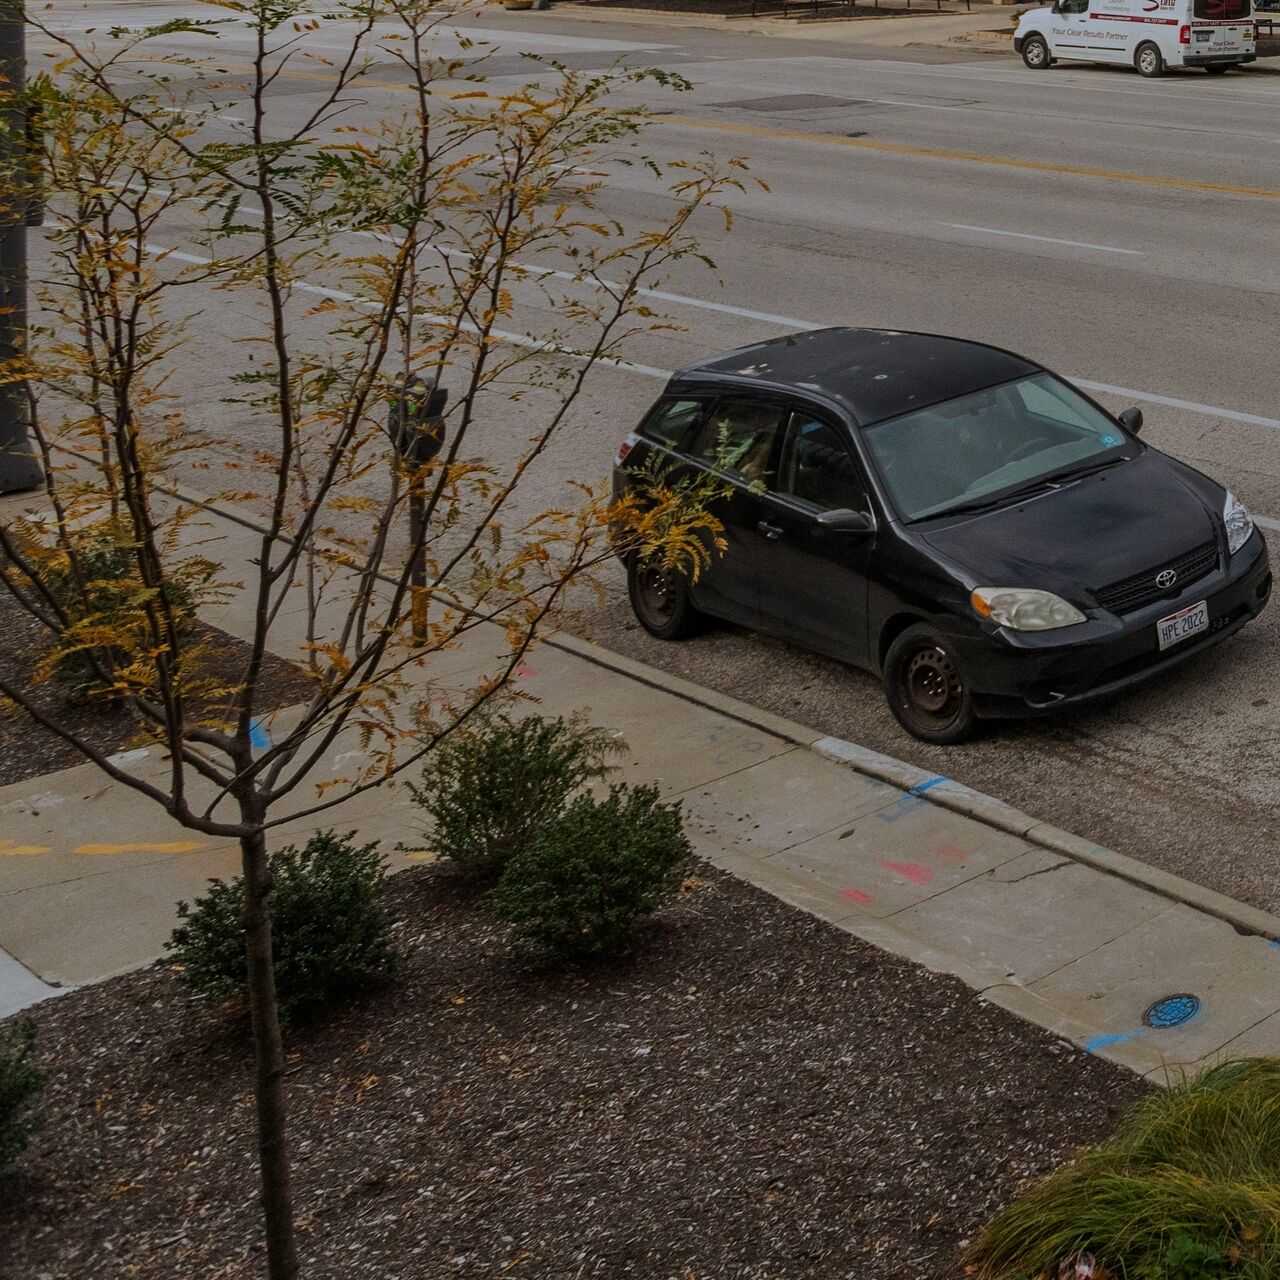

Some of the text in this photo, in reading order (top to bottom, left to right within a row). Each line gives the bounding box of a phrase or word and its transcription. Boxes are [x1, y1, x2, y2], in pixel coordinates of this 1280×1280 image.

[1052, 27, 1128, 40] Your Clear Results Partner
[1162, 621, 1180, 642] HPE
[1182, 610, 1205, 632] 2022
